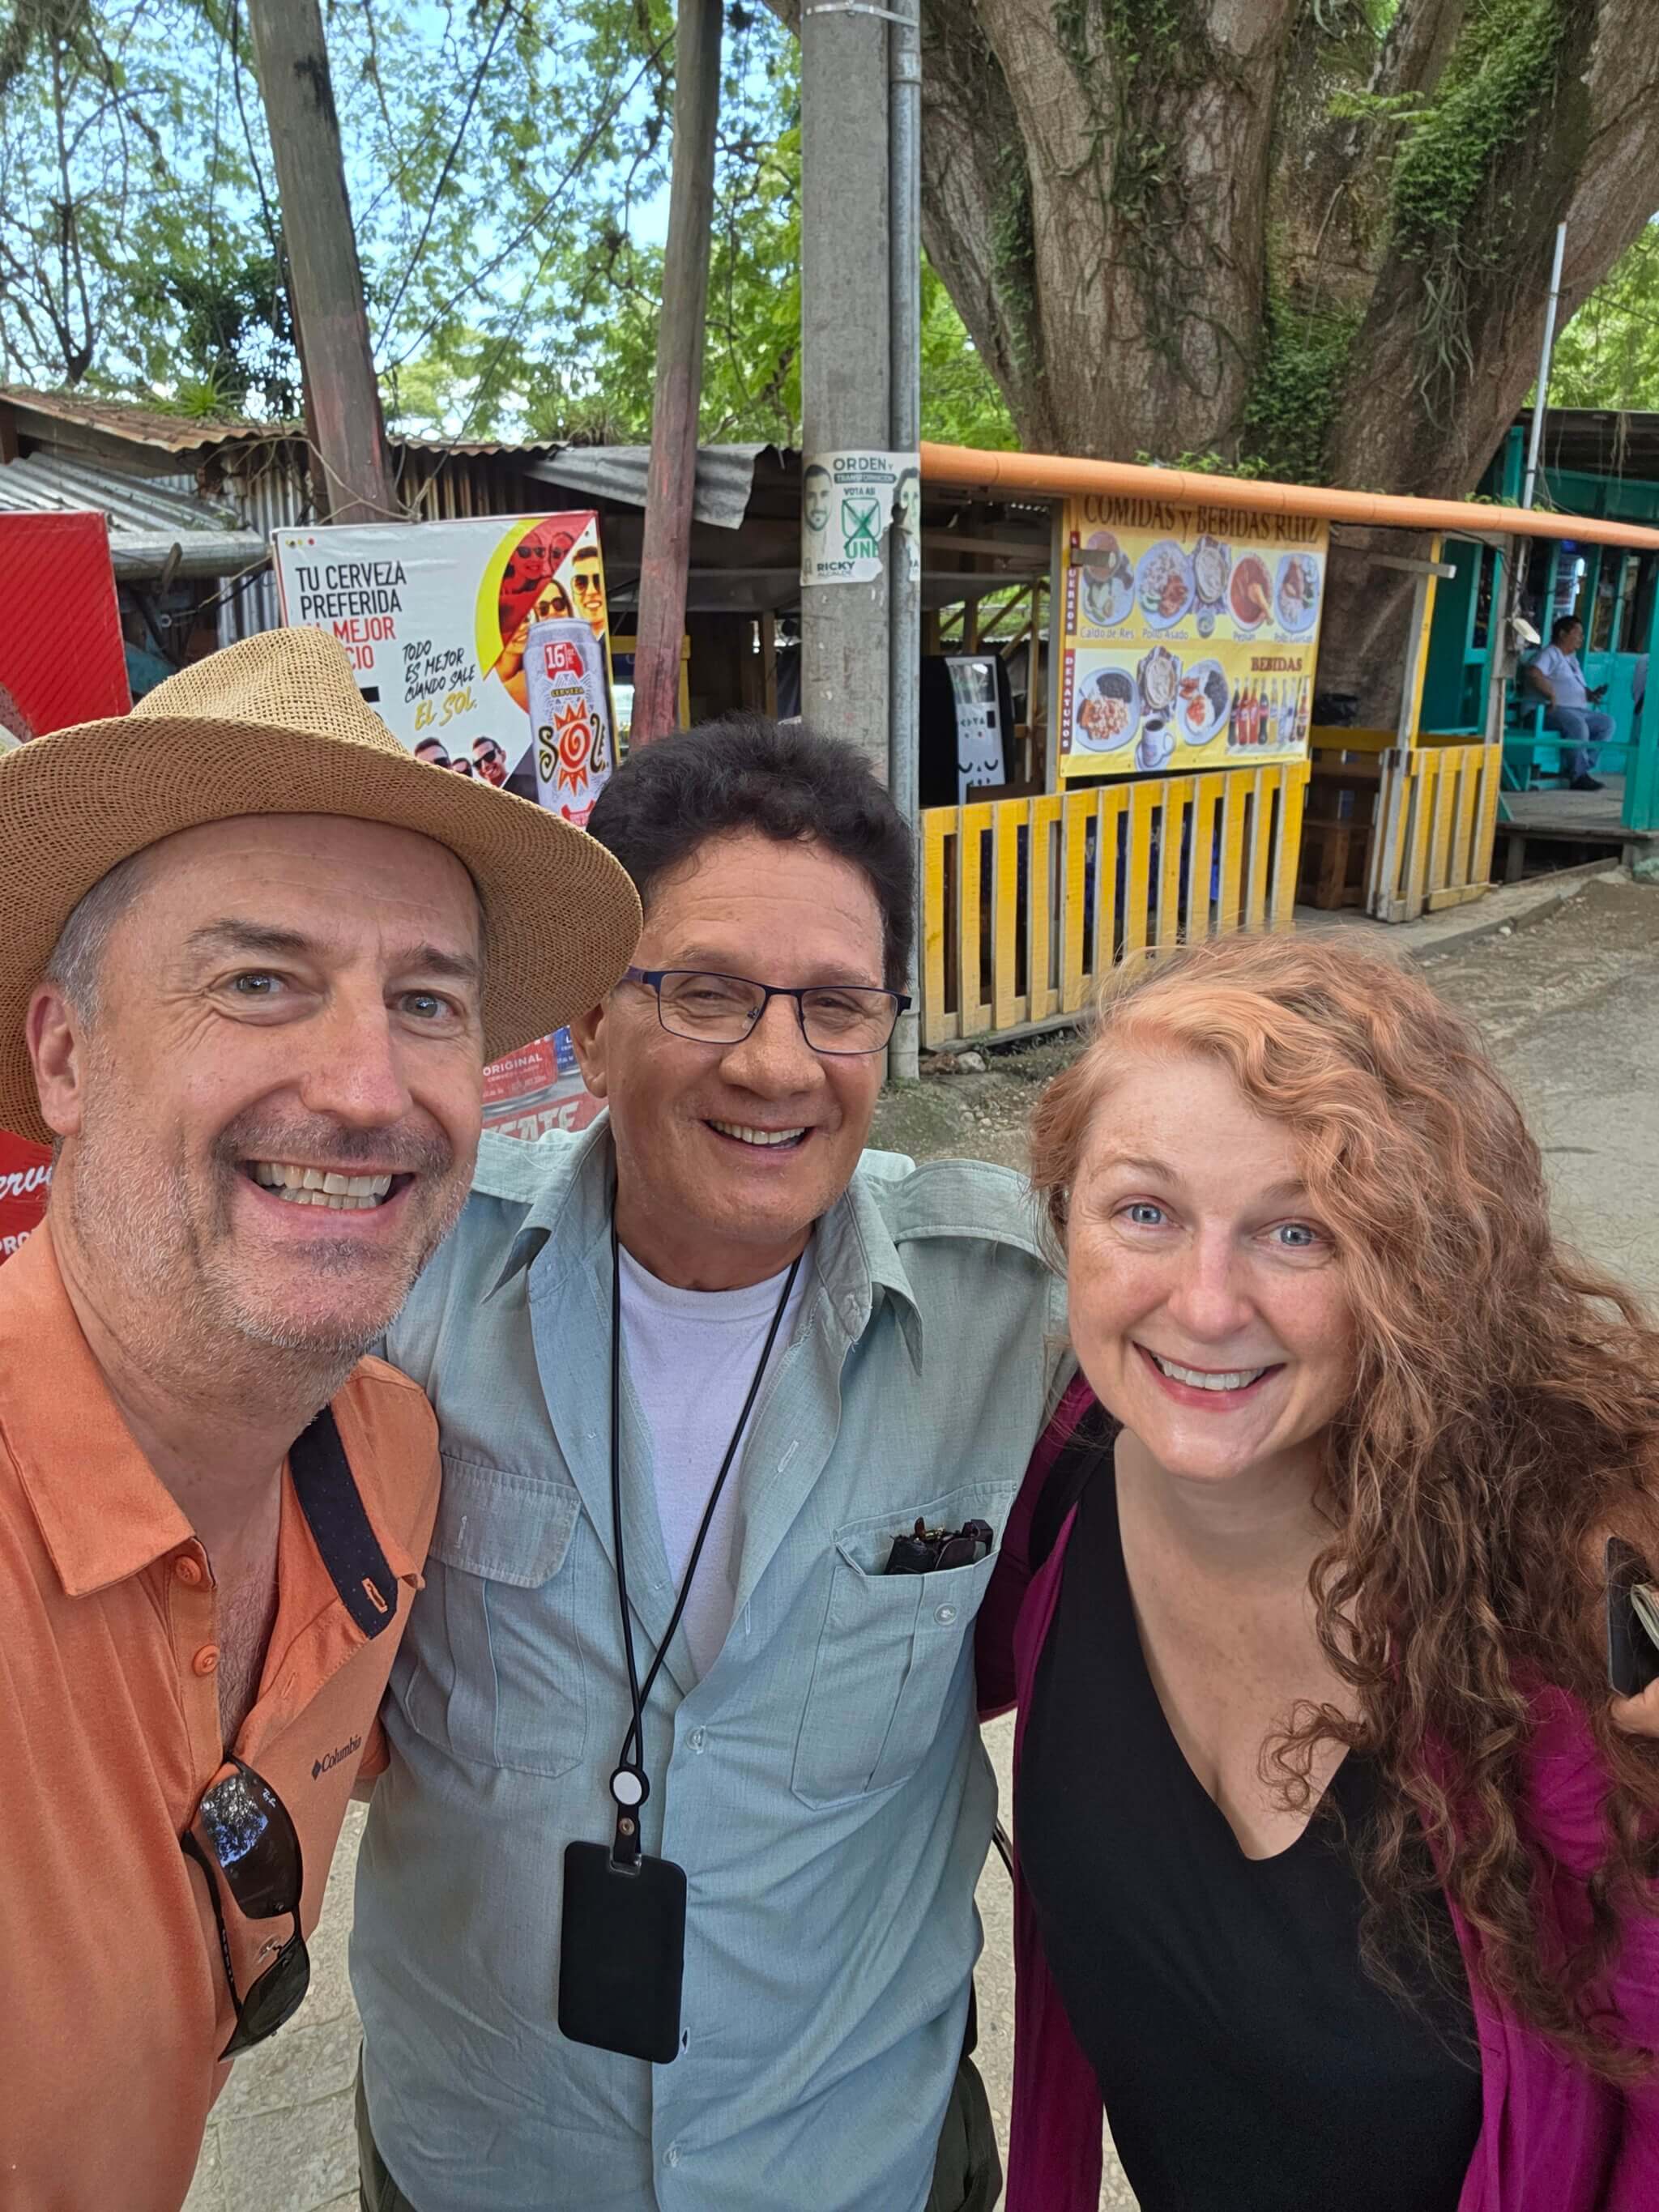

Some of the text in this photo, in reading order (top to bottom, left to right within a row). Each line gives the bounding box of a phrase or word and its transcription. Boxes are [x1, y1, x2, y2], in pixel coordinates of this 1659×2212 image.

[833, 457, 886, 471] ORDEN
[1085, 492, 1175, 531] COMIDAS
[1197, 505, 1270, 540] BEBIDAS
[1274, 514, 1319, 543] RUIZ
[295, 560, 407, 592] TU CERVEZA
[817, 560, 855, 572] RICKY
[301, 589, 402, 620] PREFERIDA
[333, 616, 396, 644] MEJOR
[345, 645, 374, 671] CIO
[402, 640, 432, 665] TODO
[405, 648, 465, 684] ES MEJOR
[546, 644, 565, 669] 16
[1251, 657, 1303, 671] BEBIDAS
[405, 664, 476, 703] CUANDO SALE
[415, 699, 437, 731] EL
[483, 1054, 543, 1076] ORIGINAL
[322, 1734, 361, 1773] Columbia
